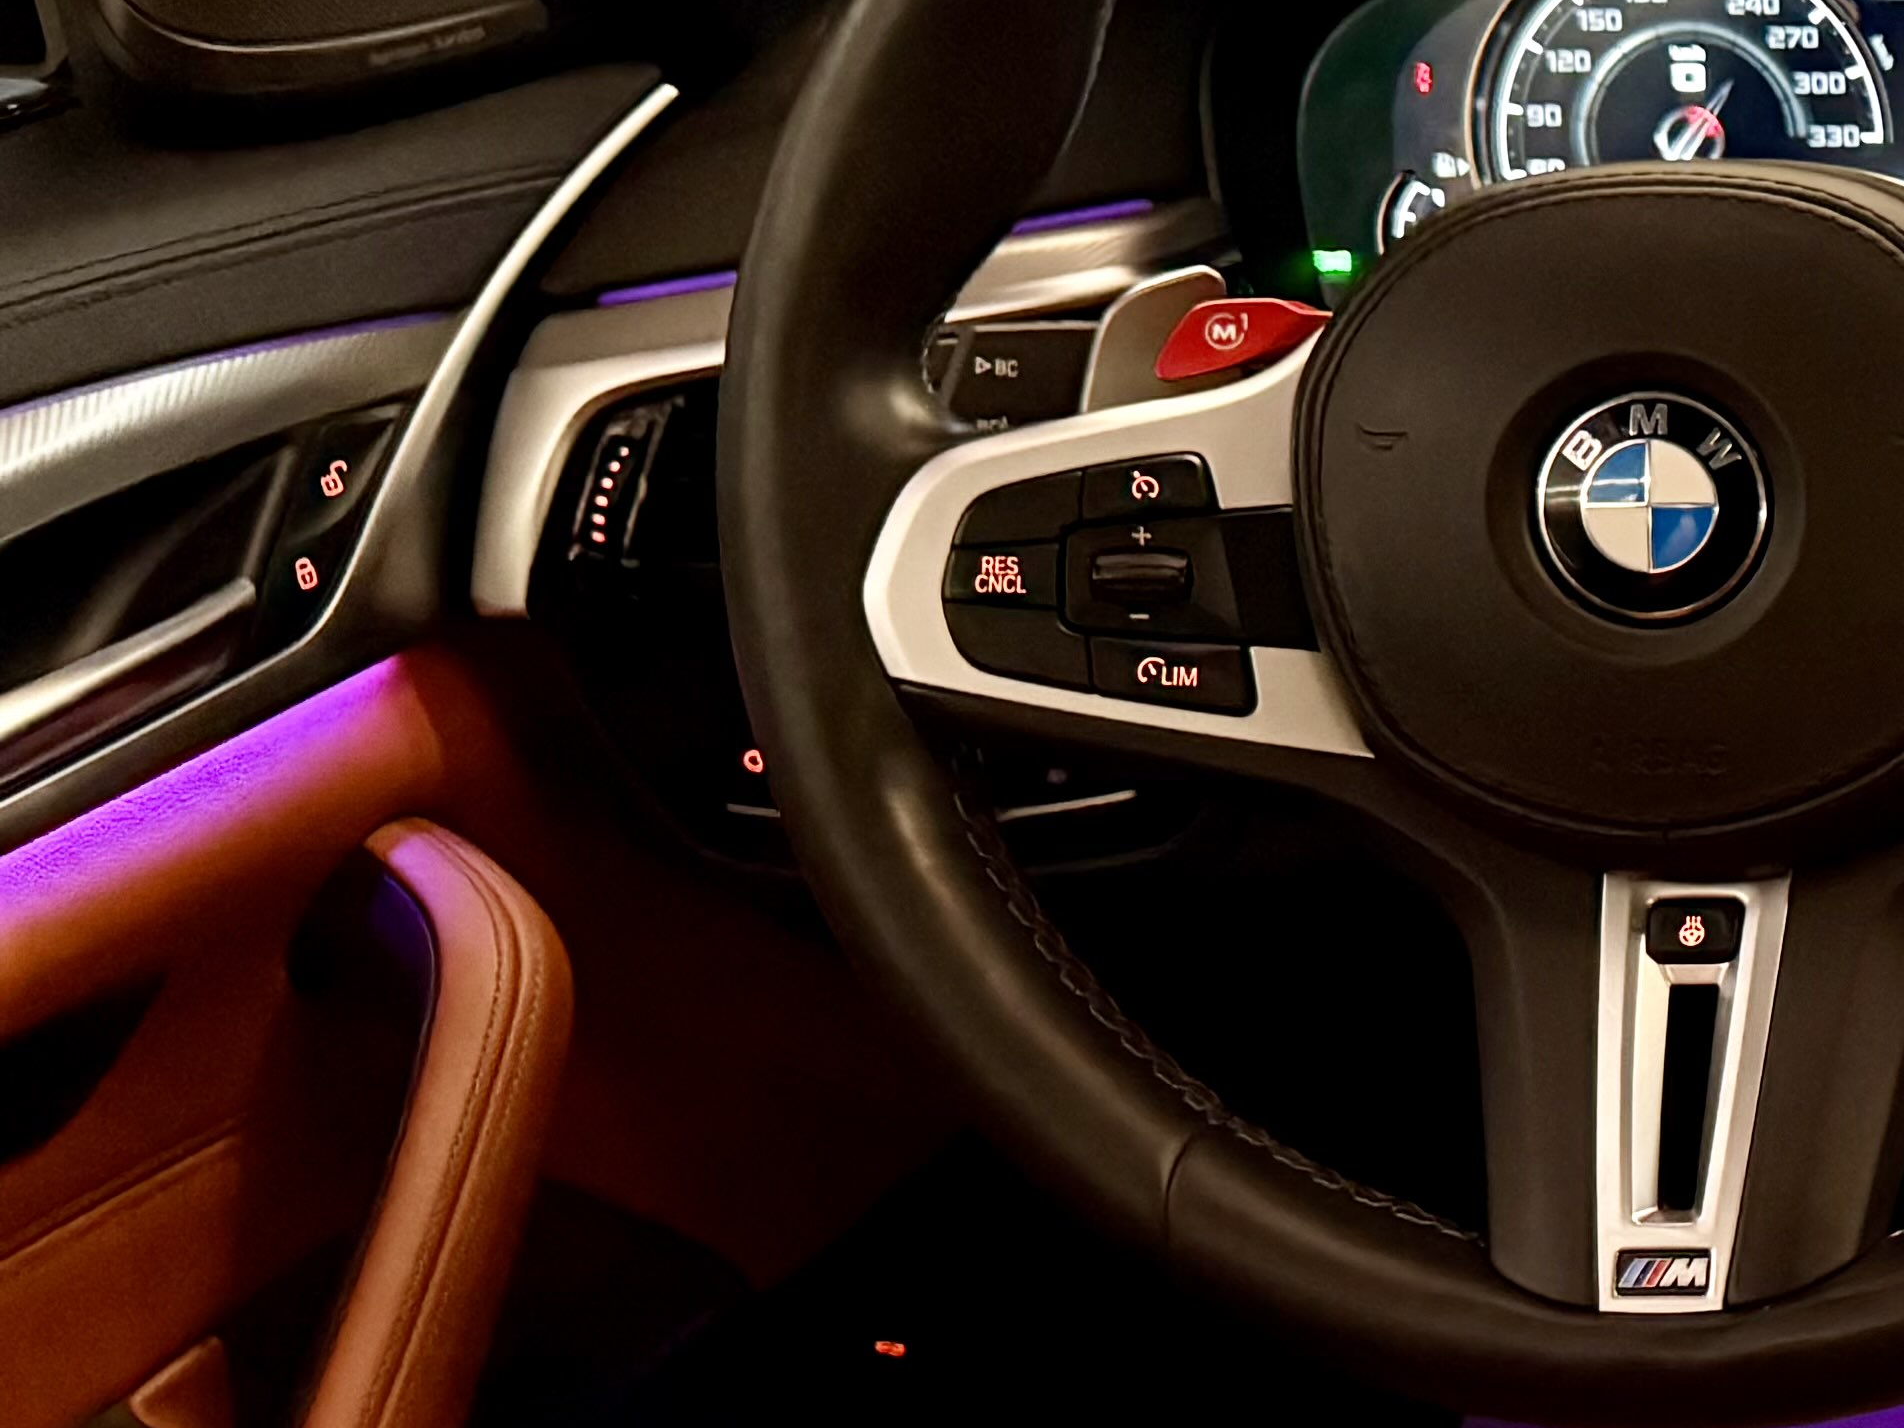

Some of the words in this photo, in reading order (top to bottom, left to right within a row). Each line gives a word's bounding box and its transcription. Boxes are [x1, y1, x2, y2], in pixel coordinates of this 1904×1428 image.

[1576, 9, 1623, 32] 150
[1766, 26, 1819, 50] 270
[1545, 50, 1592, 73] 120
[1794, 72, 1846, 95] 300
[1527, 104, 1562, 128] 90
[1807, 124, 1860, 148] 330
[1561, 403, 1742, 471] BMW
[981, 556, 1019, 575] RES
[975, 574, 1026, 595] CNCL
[1161, 667, 1198, 687] LIM
